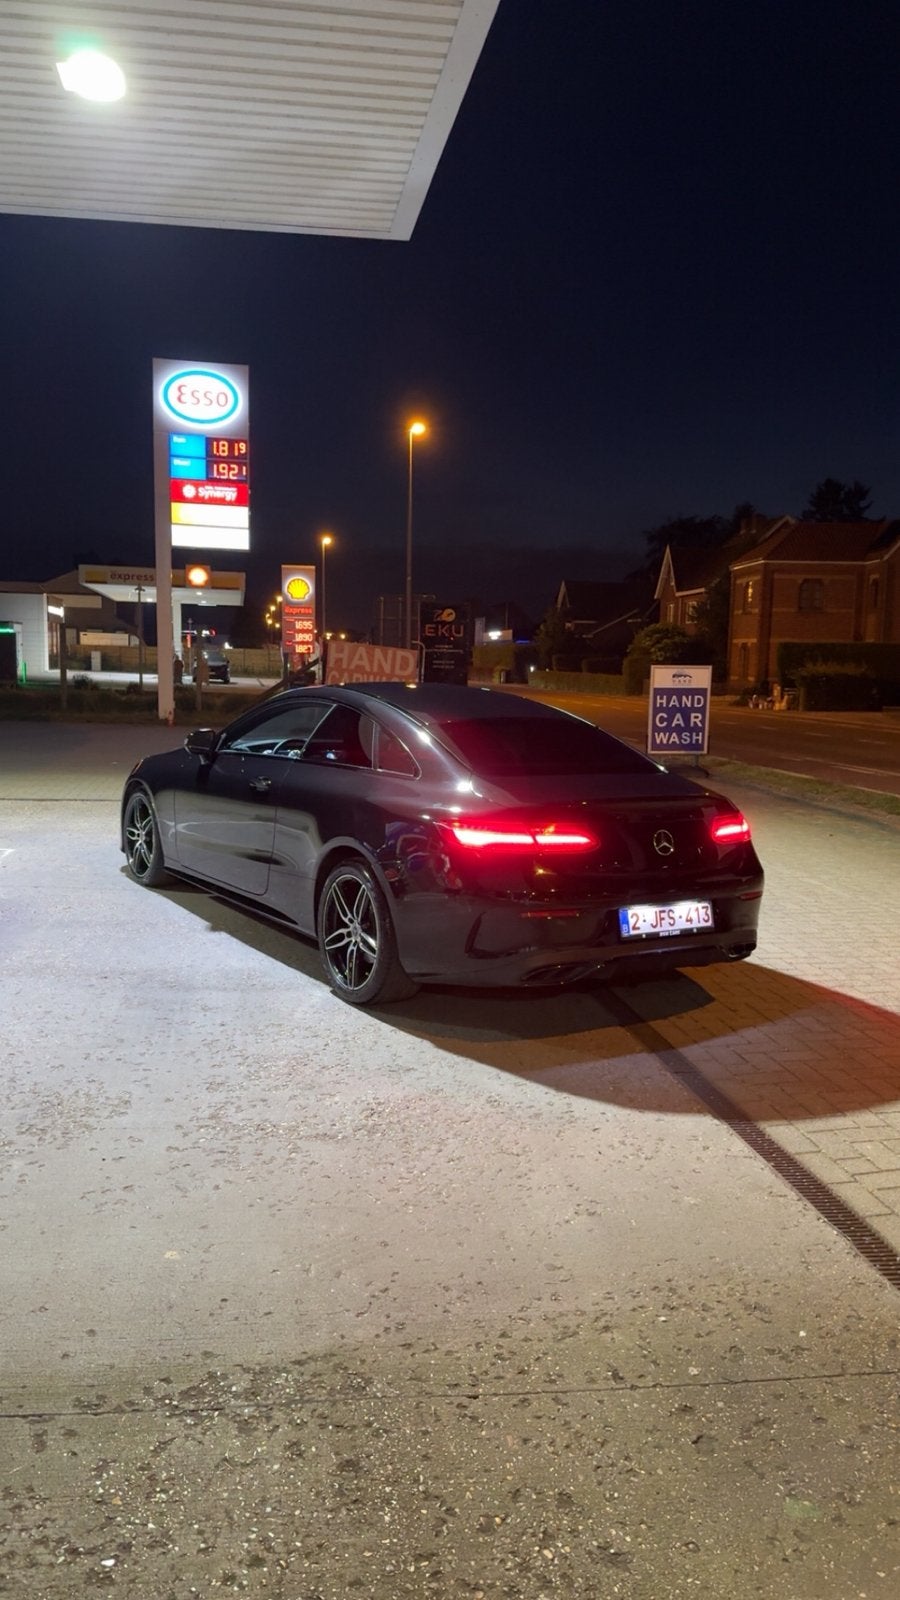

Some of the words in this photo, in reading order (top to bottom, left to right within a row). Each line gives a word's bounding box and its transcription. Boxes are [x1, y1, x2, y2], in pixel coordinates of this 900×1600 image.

[198, 486, 237, 501] Synergy
[424, 623, 465, 638] EKU
[329, 642, 415, 676] HAND
[656, 695, 705, 708] HAND
[655, 712, 703, 727] CAR
[655, 732, 703, 745] WASH
